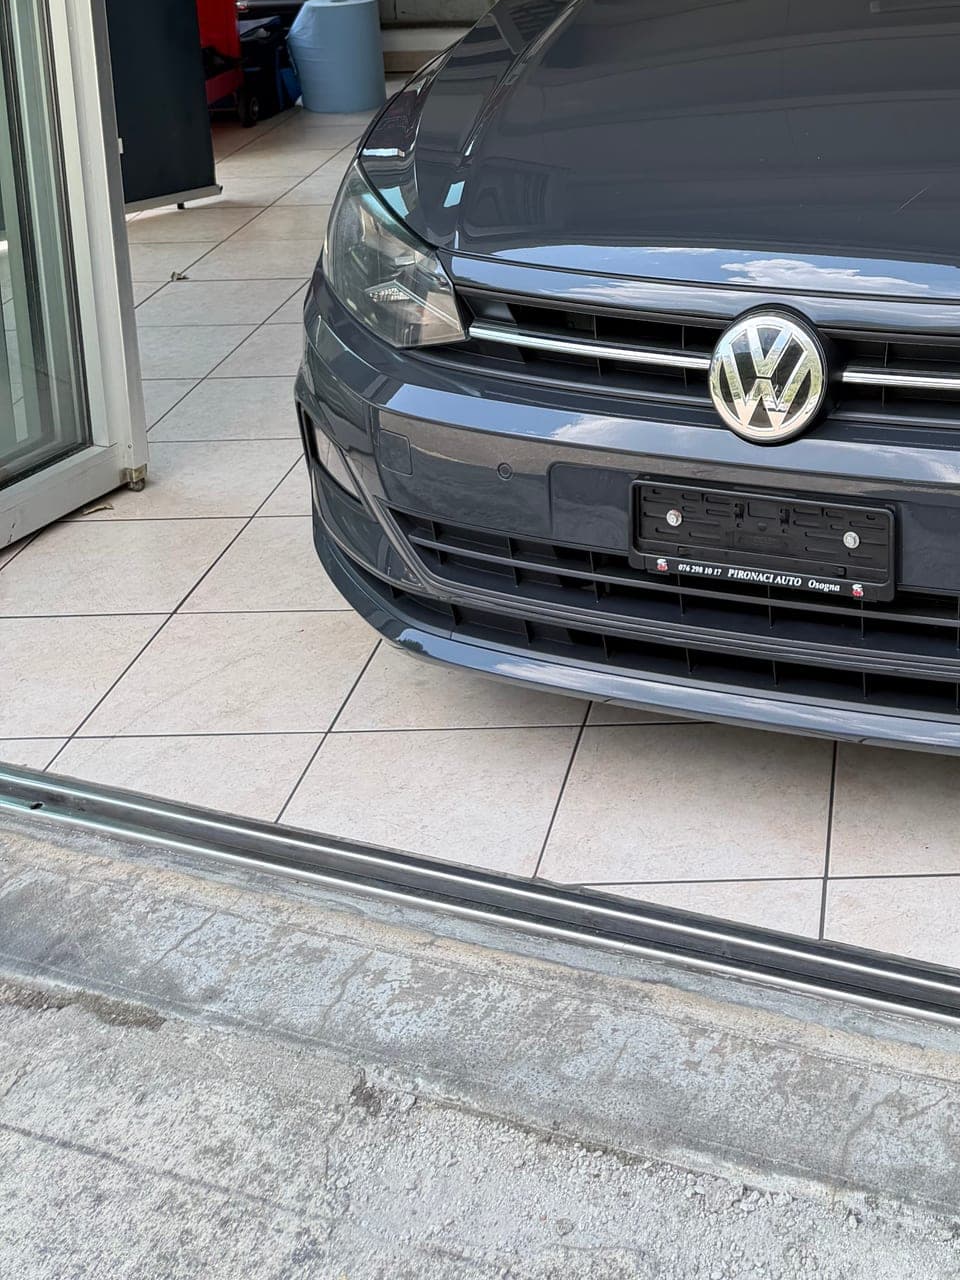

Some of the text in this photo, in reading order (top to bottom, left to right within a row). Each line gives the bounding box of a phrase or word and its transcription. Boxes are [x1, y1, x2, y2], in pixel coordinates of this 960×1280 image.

[718, 321, 816, 434] VW
[678, 563, 690, 572] 076
[704, 567, 713, 575] 10
[713, 568, 722, 576] 17
[727, 568, 774, 583] PIRONACI
[774, 575, 802, 587] AUTO
[808, 579, 841, 593] Osogna
